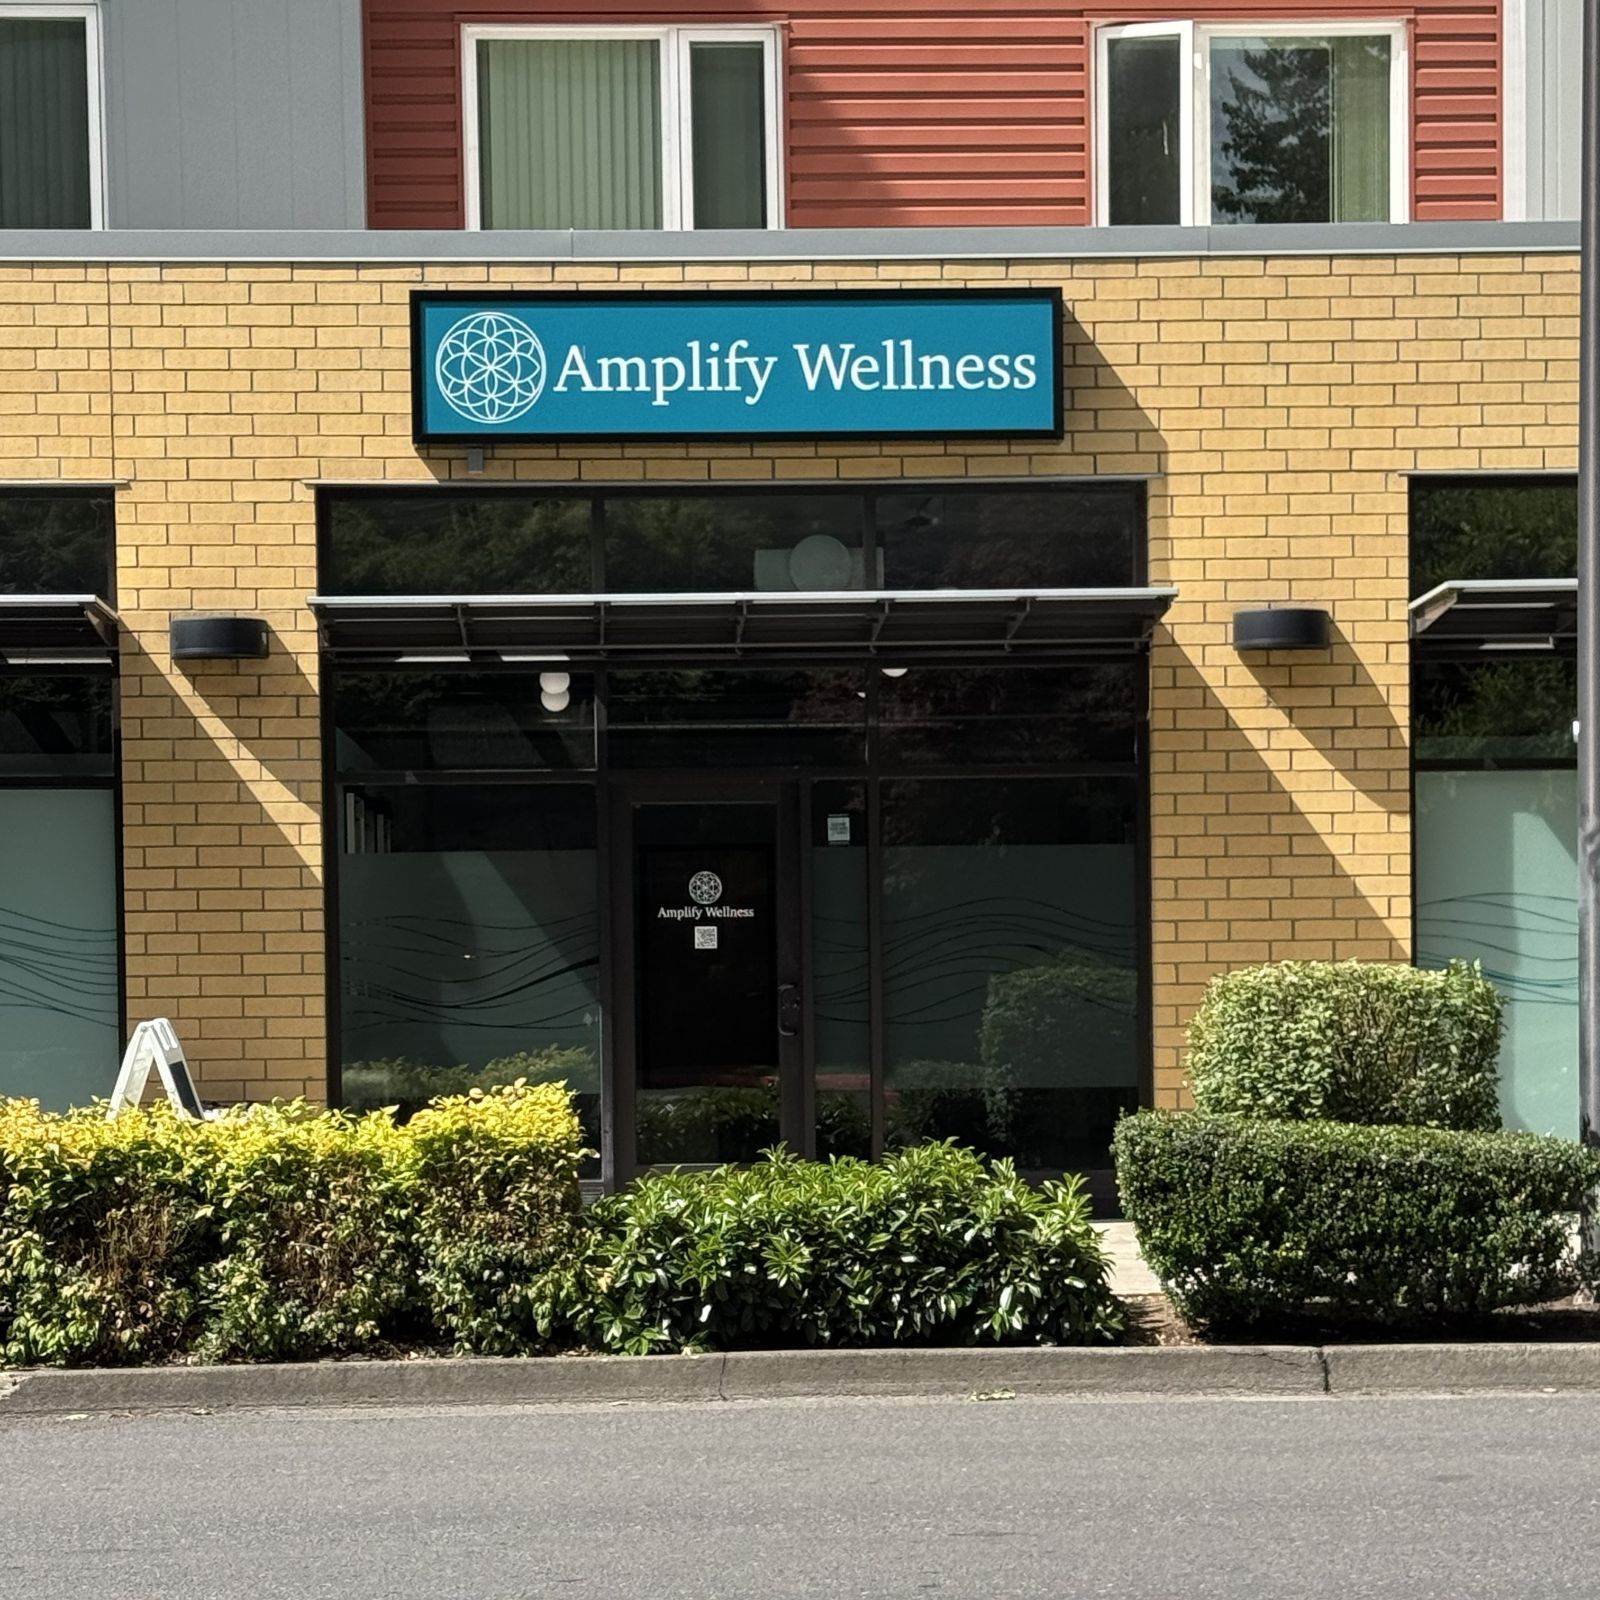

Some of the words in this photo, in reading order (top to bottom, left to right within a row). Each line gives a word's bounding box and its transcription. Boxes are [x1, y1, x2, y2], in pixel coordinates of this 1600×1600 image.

[553, 340, 778, 406] Amplify
[792, 339, 1037, 391] Wellness
[657, 905, 703, 921] Amplify
[705, 905, 755, 918] Wellness
